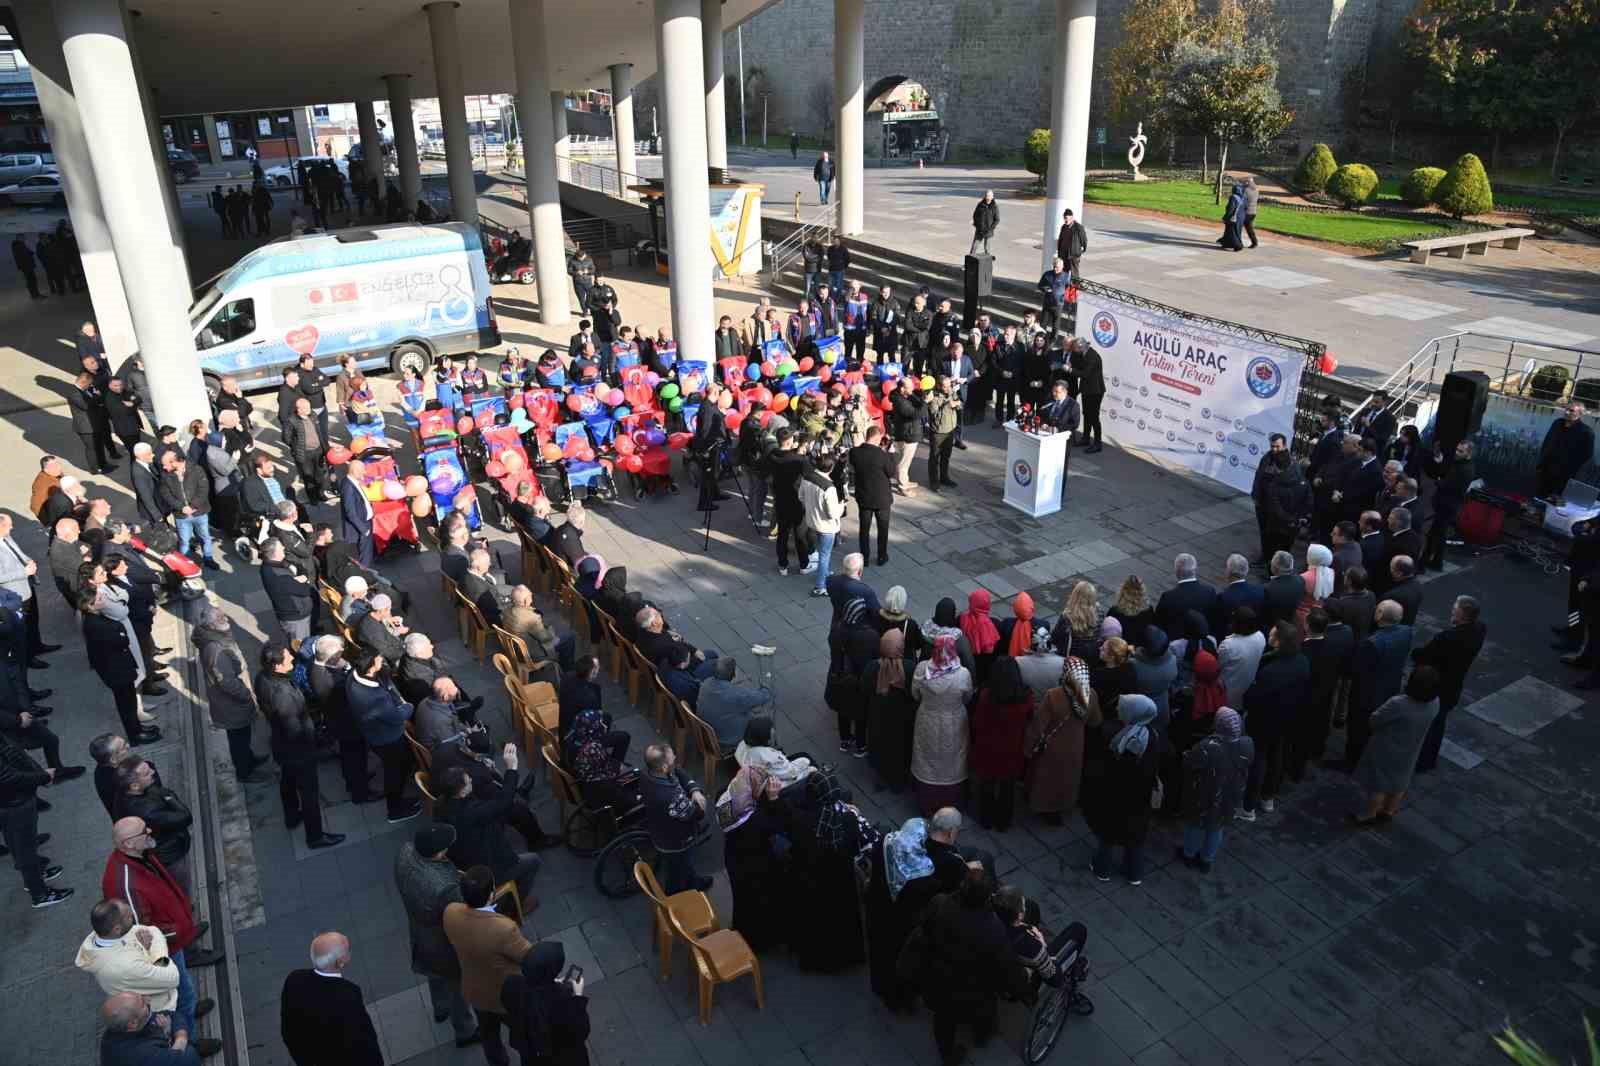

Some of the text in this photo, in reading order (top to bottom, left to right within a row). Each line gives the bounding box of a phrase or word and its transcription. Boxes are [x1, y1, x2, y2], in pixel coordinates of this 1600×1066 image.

[1133, 330, 1181, 357] AKÜLÜ
[1184, 345, 1228, 374] ARAÇ
[1140, 348, 1174, 373] Teslim
[1178, 360, 1216, 386] Töreni
